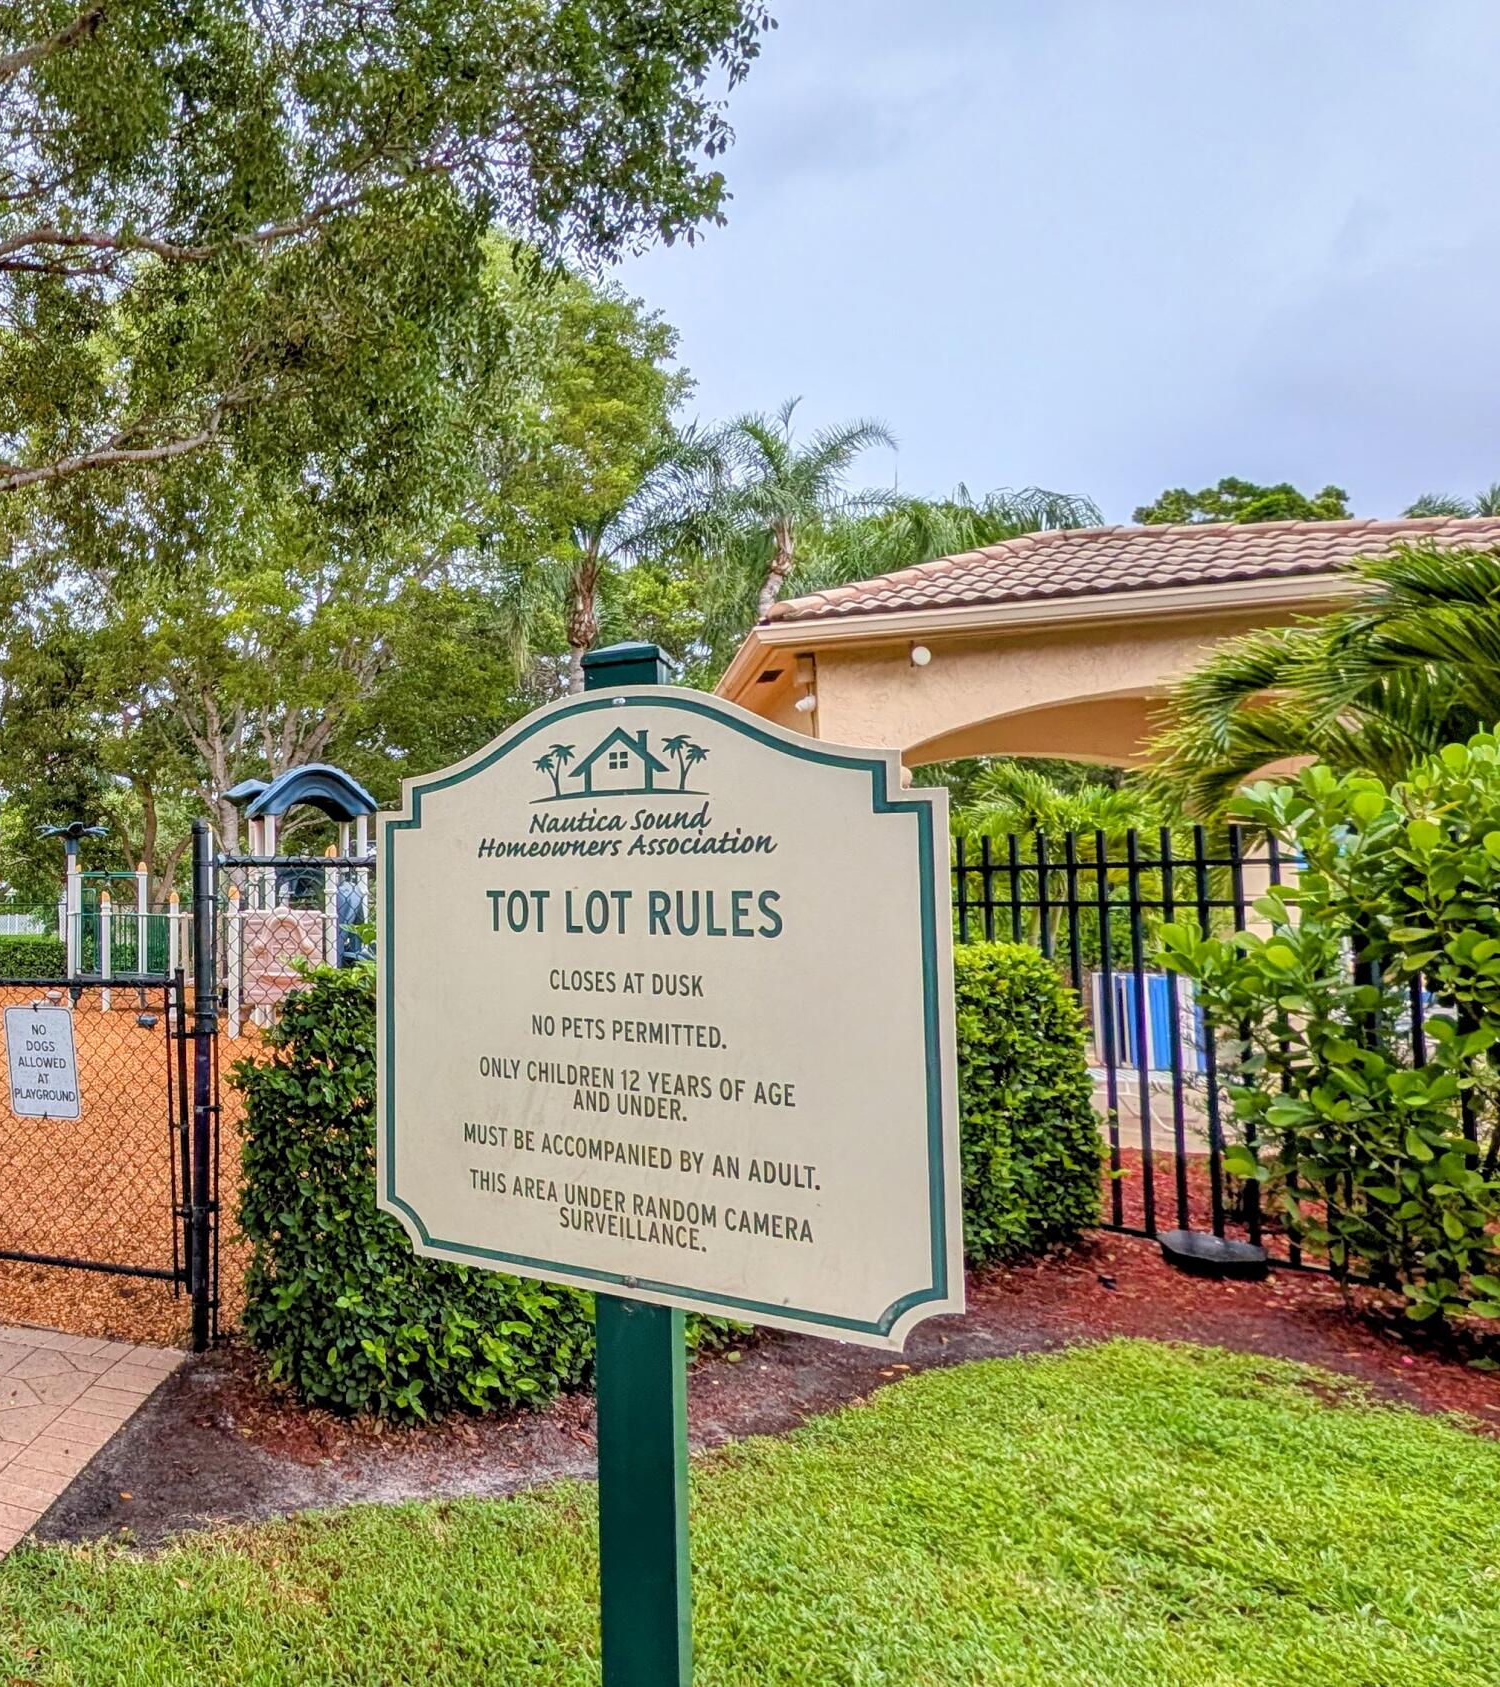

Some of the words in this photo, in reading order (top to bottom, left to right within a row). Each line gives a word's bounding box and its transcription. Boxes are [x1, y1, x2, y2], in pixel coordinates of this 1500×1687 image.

[529, 808, 628, 834] Nautica
[630, 801, 712, 830] Sound
[478, 835, 622, 859] Homeowners
[627, 828, 778, 857] Association
[486, 890, 550, 932] TOT
[565, 890, 632, 935] LOT
[649, 890, 783, 938] RULES
[550, 969, 616, 993] CLOSES
[623, 973, 644, 994] AT
[652, 973, 704, 997] DUSK
[26, 1040, 55, 1052] DOGS
[31, 1024, 47, 1036] NO
[532, 1014, 555, 1036] NO
[562, 1017, 605, 1040] PETS
[612, 1020, 727, 1050] PERMITTED.
[18, 1056, 66, 1069] ALLOWED
[38, 1073, 49, 1084] AT
[14, 1088, 75, 1102] PLAYGROUND
[479, 1056, 520, 1079] ONLY
[527, 1060, 614, 1090] CHILDREN
[621, 1070, 640, 1092] 12
[648, 1072, 712, 1099] YEARS
[719, 1078, 746, 1102] OF
[754, 1081, 796, 1108] AGE
[573, 1089, 610, 1113] AND
[618, 1093, 688, 1122] UNDER.
[464, 1122, 508, 1148] MUST
[514, 1128, 535, 1151] BE
[541, 1133, 672, 1170] ACCOMPANIED
[680, 1150, 704, 1174] BY
[712, 1154, 740, 1179] AN
[749, 1159, 821, 1191] ADULT.
[470, 1169, 507, 1194] THIS
[513, 1175, 558, 1203] AREA
[565, 1184, 625, 1213] UNDER
[633, 1193, 717, 1228] RANDOM
[725, 1207, 814, 1244] CAMERA
[560, 1207, 707, 1253] SURVEILLANCE.
